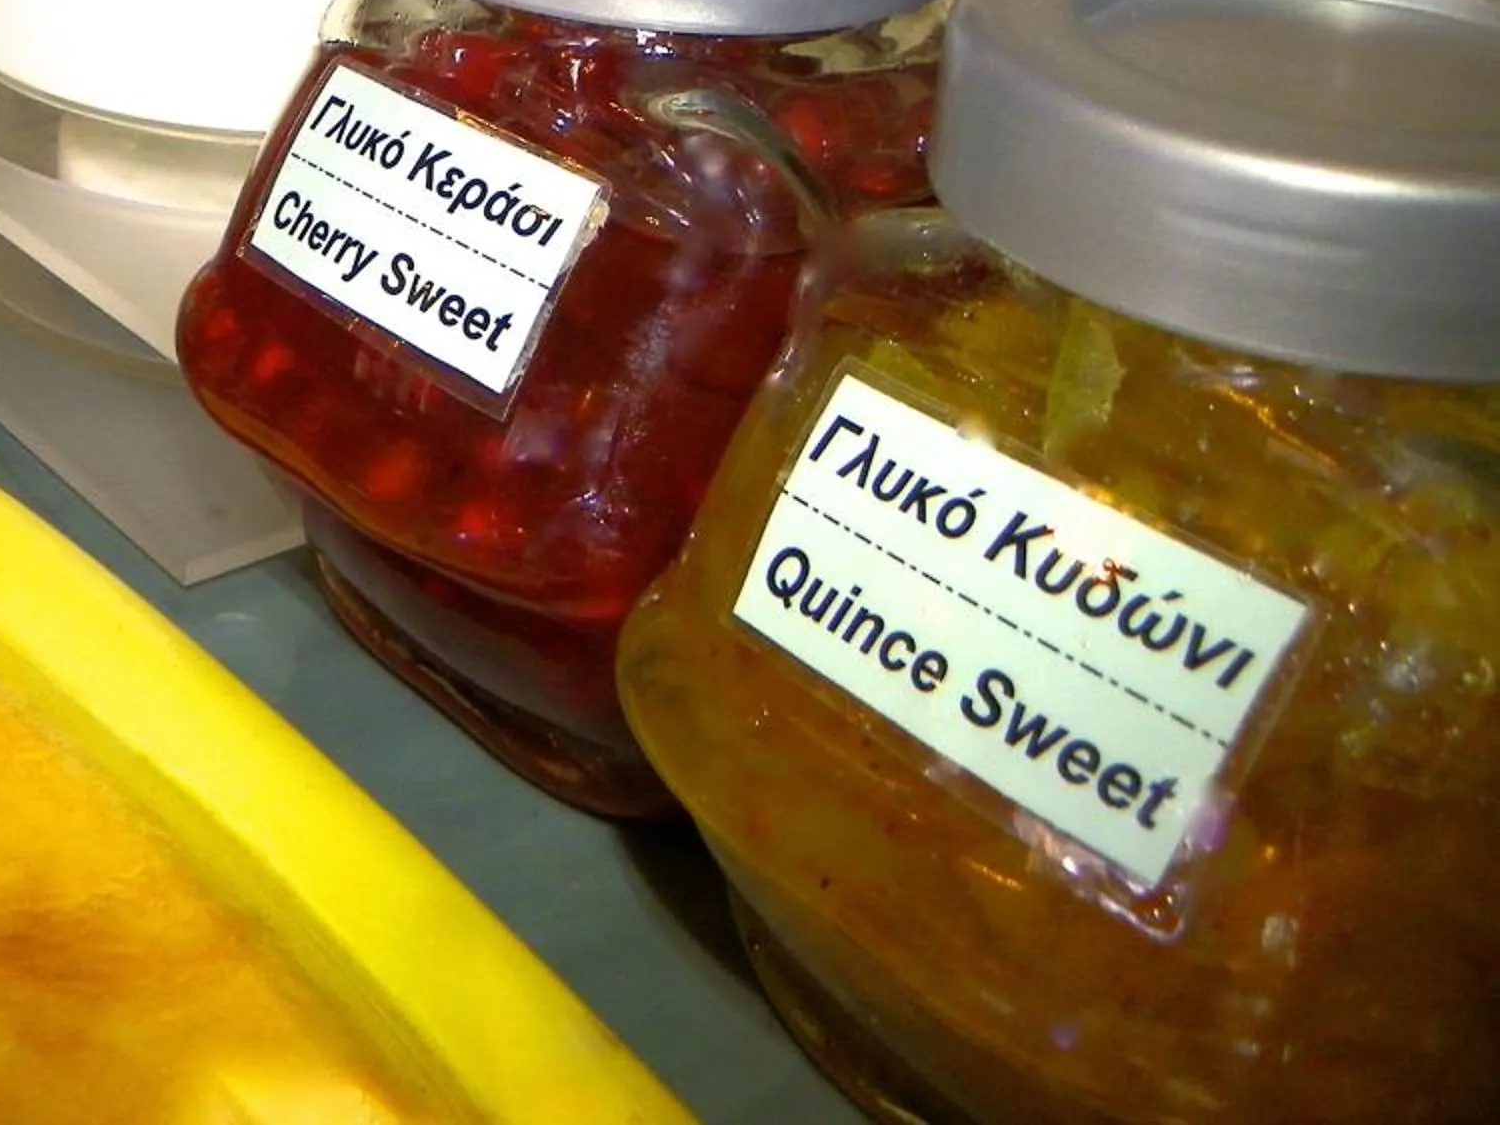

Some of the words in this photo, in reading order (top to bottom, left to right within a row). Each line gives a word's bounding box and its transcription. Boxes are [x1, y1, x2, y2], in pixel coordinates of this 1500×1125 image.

[273, 191, 379, 282] Cherry
[380, 253, 514, 351] Sweet
[309, 95, 411, 169] Γλυκό
[407, 143, 563, 247] Κεράσι
[808, 414, 987, 538] Γλυκό
[983, 511, 1255, 689] Κυδώνι
[764, 546, 949, 692] Quince
[960, 668, 1177, 829] Sweet
